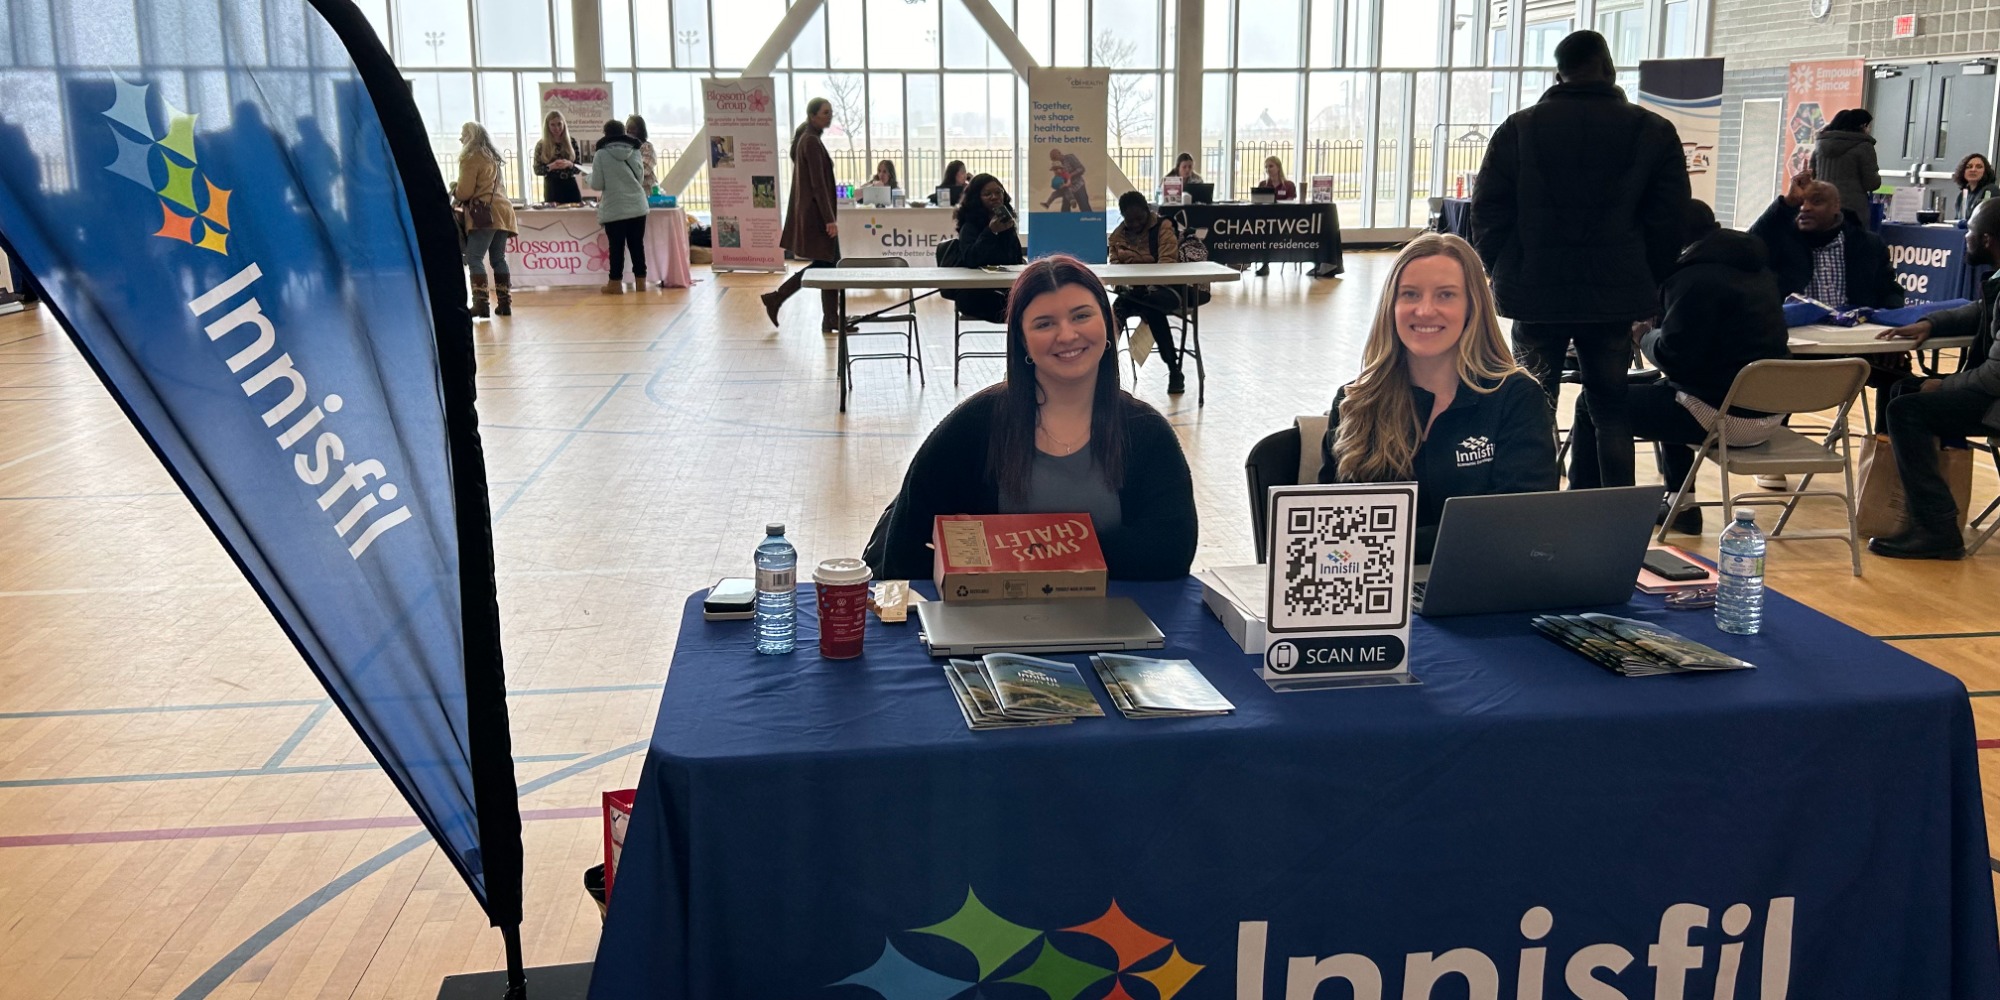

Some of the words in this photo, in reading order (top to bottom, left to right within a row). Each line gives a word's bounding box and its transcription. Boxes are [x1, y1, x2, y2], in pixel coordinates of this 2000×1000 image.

[1816, 67, 1862, 81] Empower
[1815, 80, 1850, 90] Simcoe
[706, 90, 746, 101] Blossom
[716, 100, 746, 112] Group
[1033, 101, 1073, 111] Together,
[1048, 113, 1074, 123] shape
[1034, 124, 1080, 132] healthcare
[1033, 134, 1046, 143] for
[1048, 134, 1063, 143] the
[1064, 134, 1093, 143] better.
[881, 228, 913, 247] cbi
[1213, 239, 1267, 250] retirement
[1268, 238, 1320, 249] residences
[505, 236, 581, 254] Blossom
[904, 249, 925, 257] better
[522, 252, 582, 274] Group
[188, 262, 413, 560] Innisfil
[1455, 443, 1495, 463] Innisfi
[995, 519, 1089, 549] CHALET
[1012, 538, 1081, 562] SWISS
[1320, 562, 1360, 575] Innisfil
[1306, 648, 1354, 664] SCAN
[1359, 647, 1386, 662] ME
[1236, 896, 1795, 1000] Innisfil
